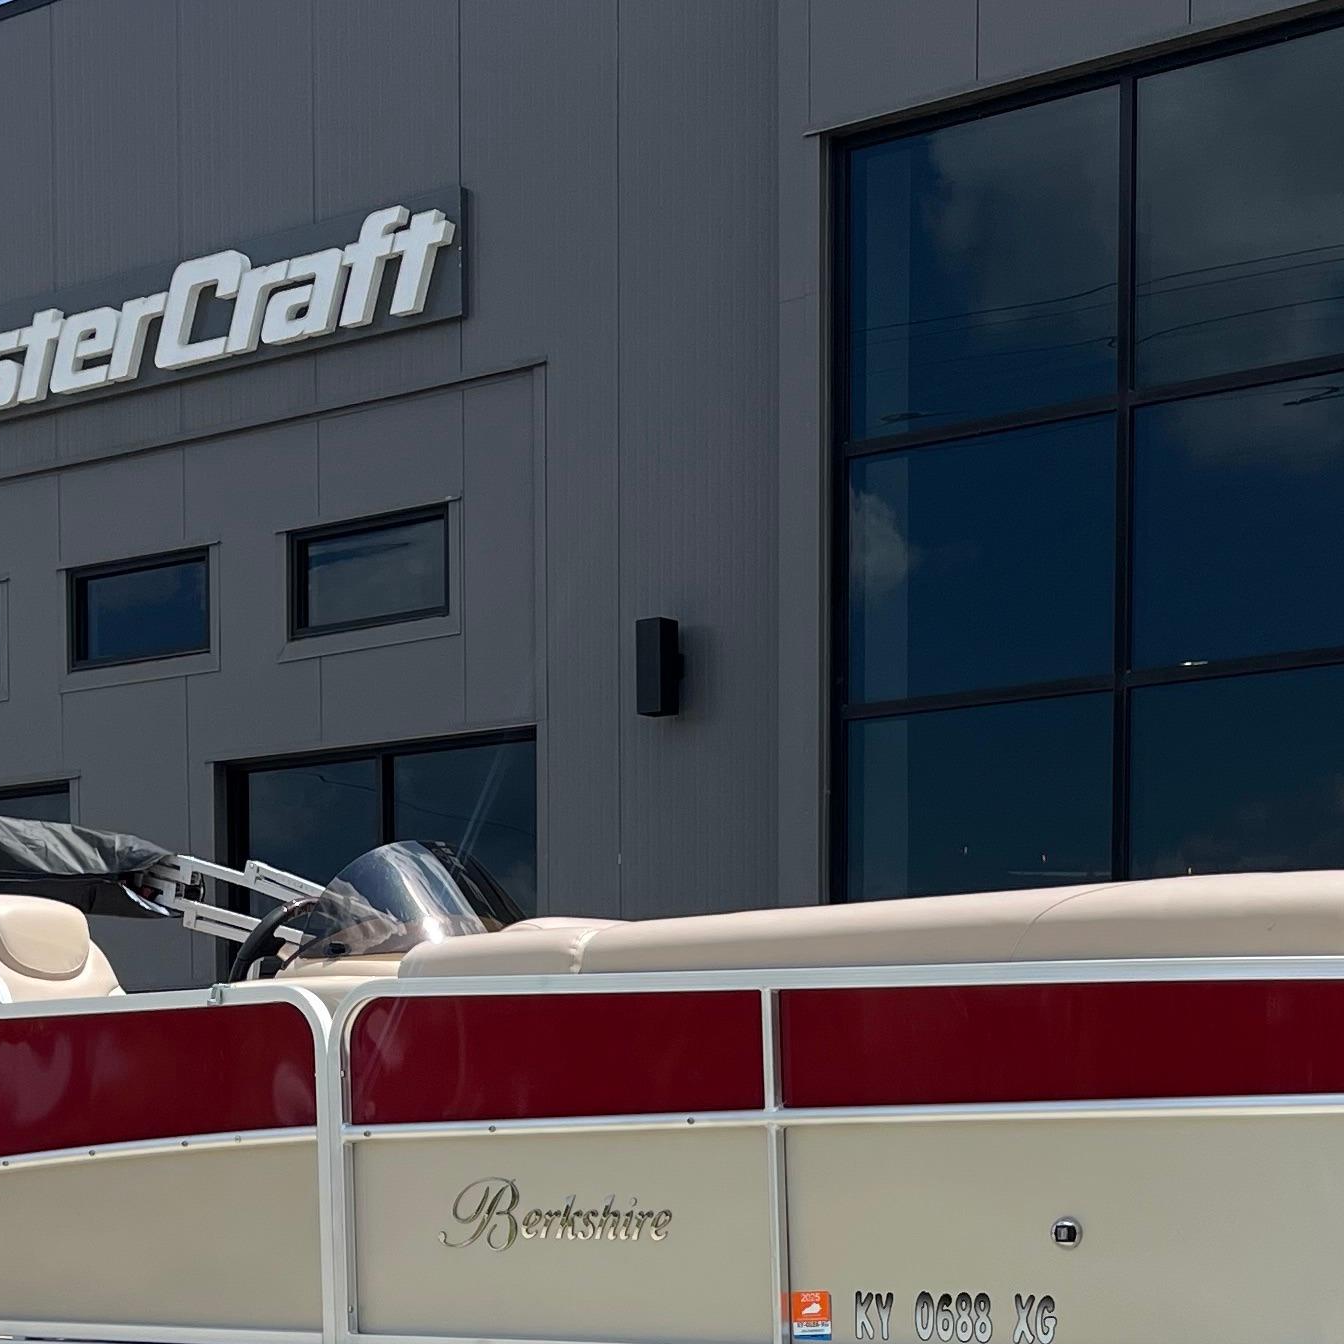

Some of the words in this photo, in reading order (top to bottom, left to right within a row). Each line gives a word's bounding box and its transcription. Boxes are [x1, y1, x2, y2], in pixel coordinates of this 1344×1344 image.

[438, 1175, 673, 1252] Berkshire
[855, 1291, 894, 1341] KY
[915, 1290, 993, 1343] 0688
